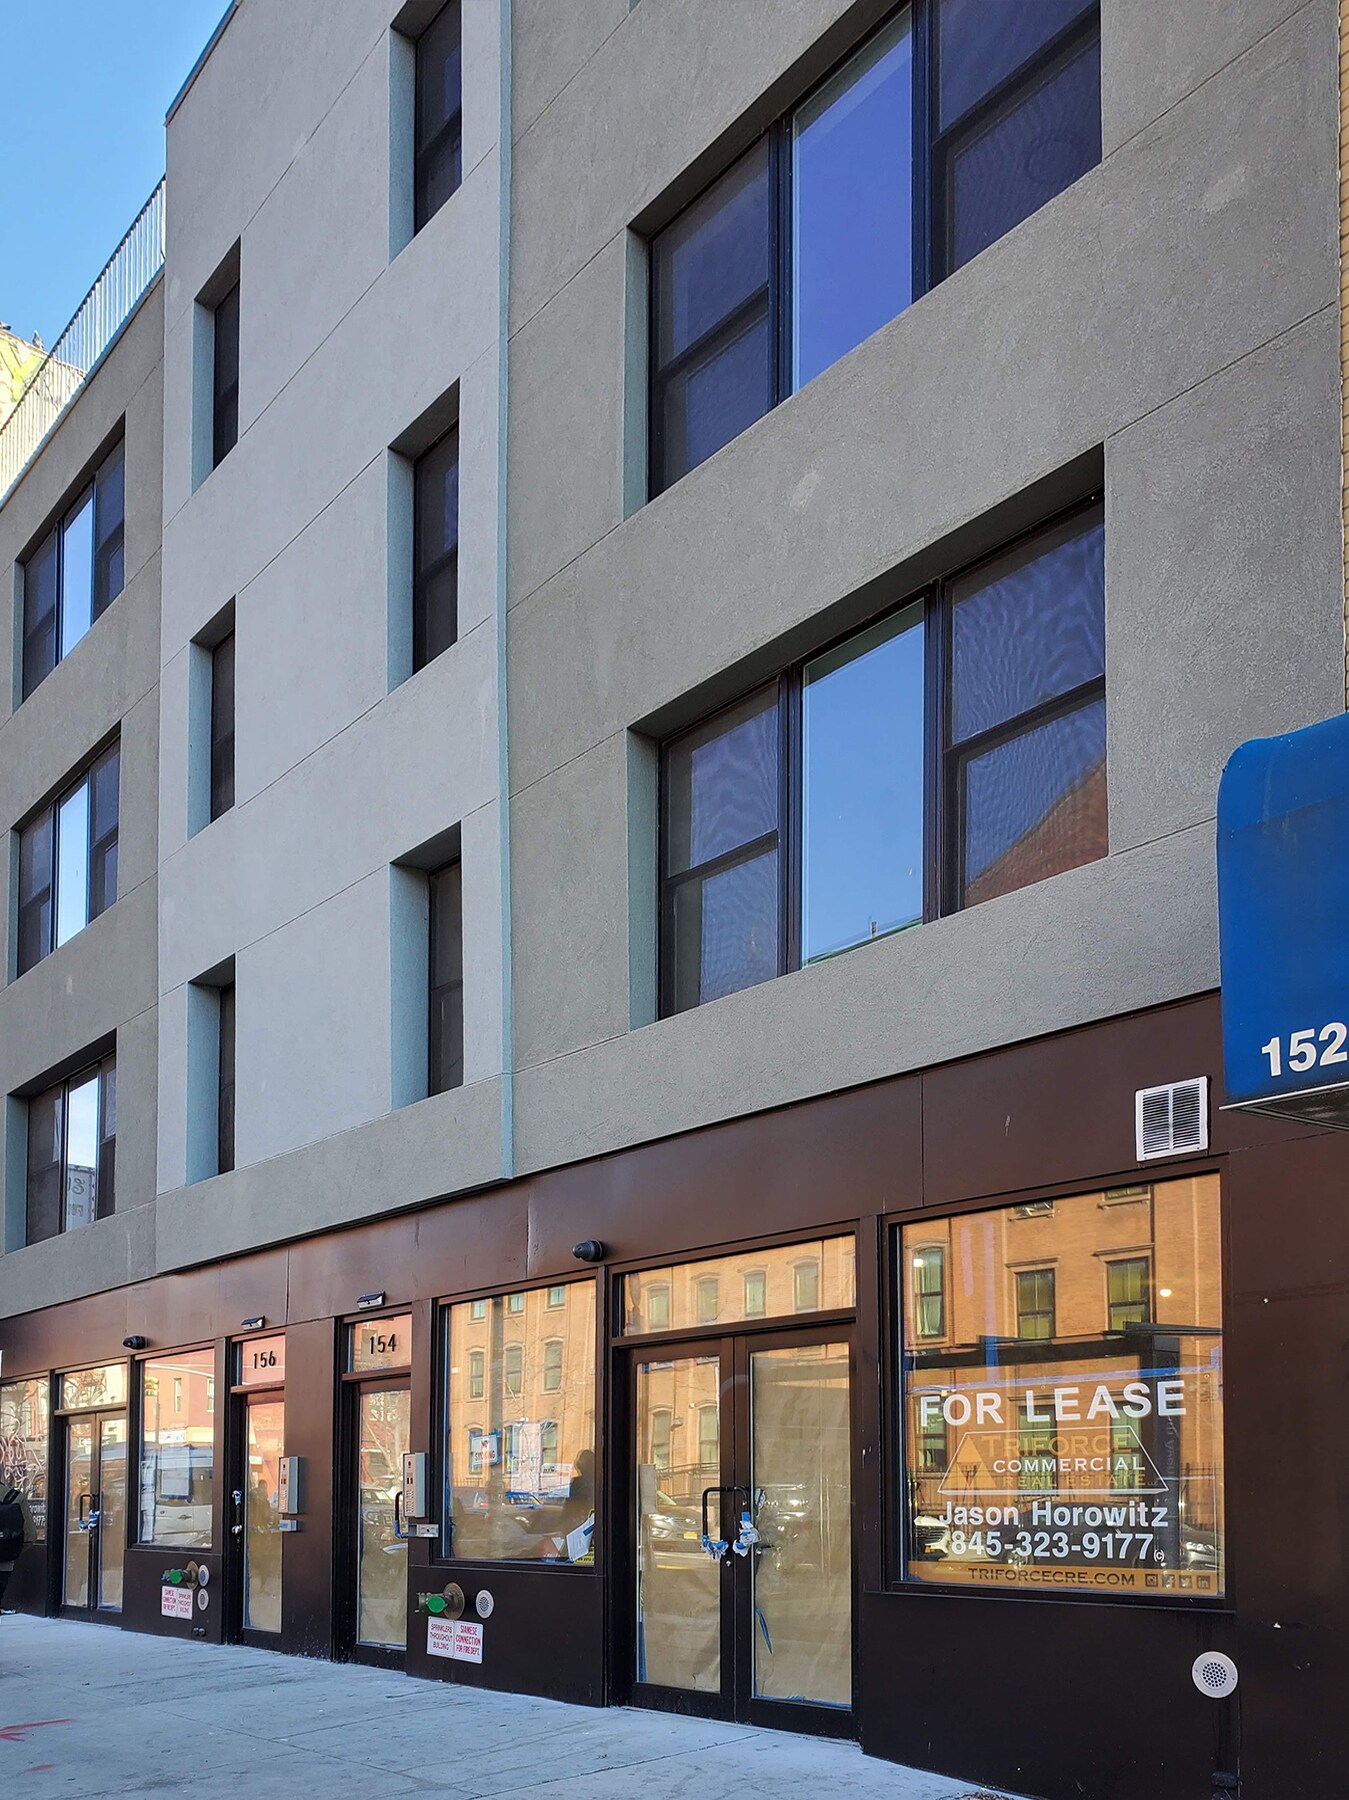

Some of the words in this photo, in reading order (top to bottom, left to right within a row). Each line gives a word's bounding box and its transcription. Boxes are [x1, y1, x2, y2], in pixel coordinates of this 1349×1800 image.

[1261, 1021, 1348, 1077] 152
[370, 1333, 397, 1354] 154
[253, 1350, 276, 1369] 156
[920, 1391, 1004, 1427] FOR
[1025, 1379, 1187, 1423] LEASE
[981, 1433, 1132, 1458] TRIFORCE
[992, 1456, 1146, 1474] COMMERCIAL
[1002, 1475, 1057, 1488] REAL
[1065, 1470, 1146, 1488] ESTATE
[938, 1500, 1019, 1527] Jason
[1032, 1499, 1169, 1527] Horowitz
[951, 1530, 1154, 1560] 845-323-9177
[968, 1567, 1135, 1586] TRIFORCECRE.COM
[455, 1634, 481, 1646] CONNECTION
